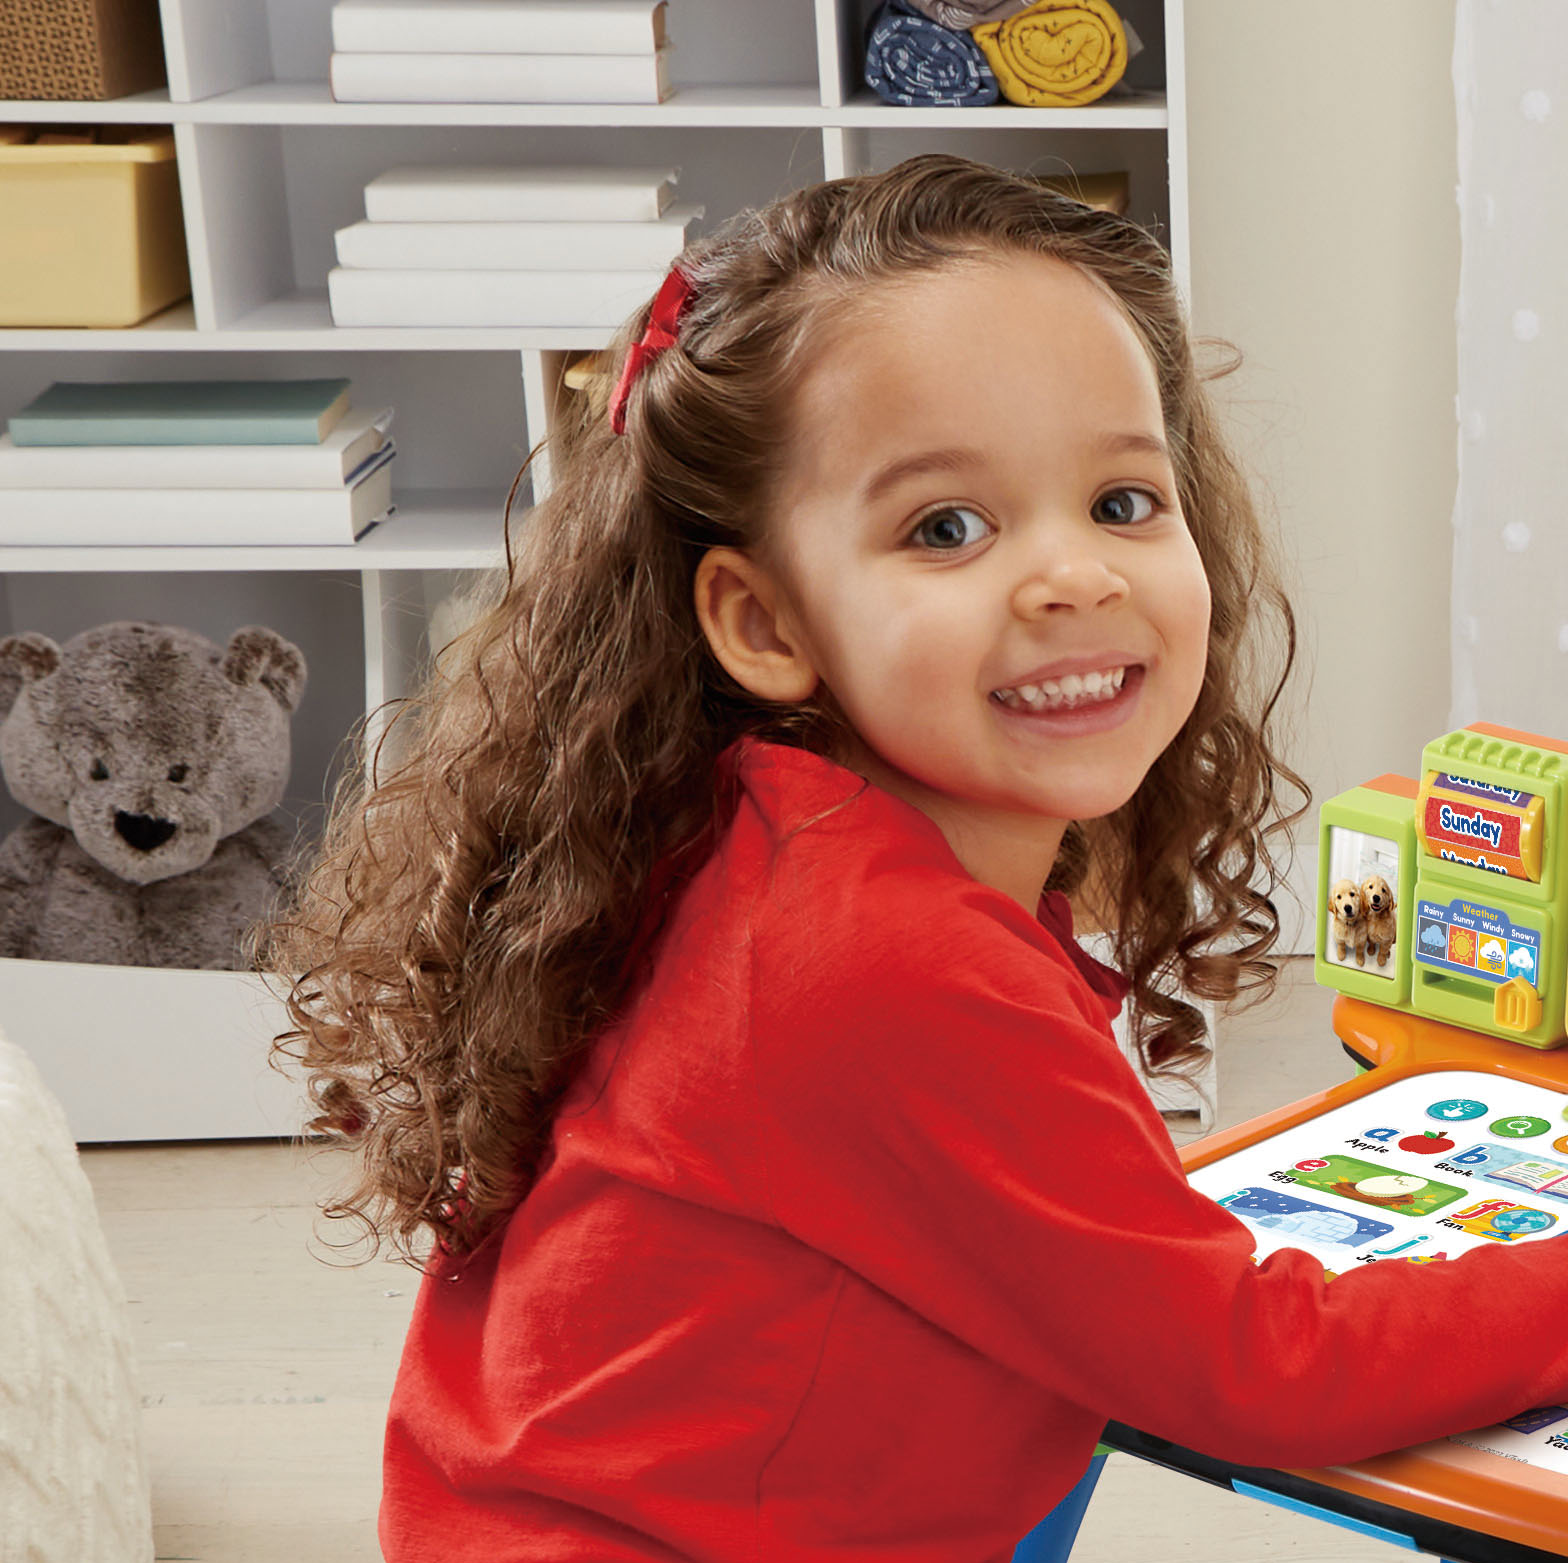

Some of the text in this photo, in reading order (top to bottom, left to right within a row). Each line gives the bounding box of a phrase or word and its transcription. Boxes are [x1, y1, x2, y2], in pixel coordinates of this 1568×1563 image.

[1441, 806, 1501, 847] Sunday
[1462, 903, 1499, 921] Weather
[1423, 904, 1535, 944] Rainy Sunny Windy Snowy
[1364, 1128, 1400, 1142] a
[1345, 1138, 1389, 1154] Apple
[1451, 1146, 1489, 1164] b
[1295, 1160, 1329, 1172] e
[1434, 1162, 1474, 1177] Book
[1268, 1171, 1297, 1184] Egg
[1451, 1201, 1517, 1219] f
[1435, 1218, 1465, 1231] Fan
[1371, 1235, 1430, 1255] j
[1356, 1254, 1377, 1263] Je
